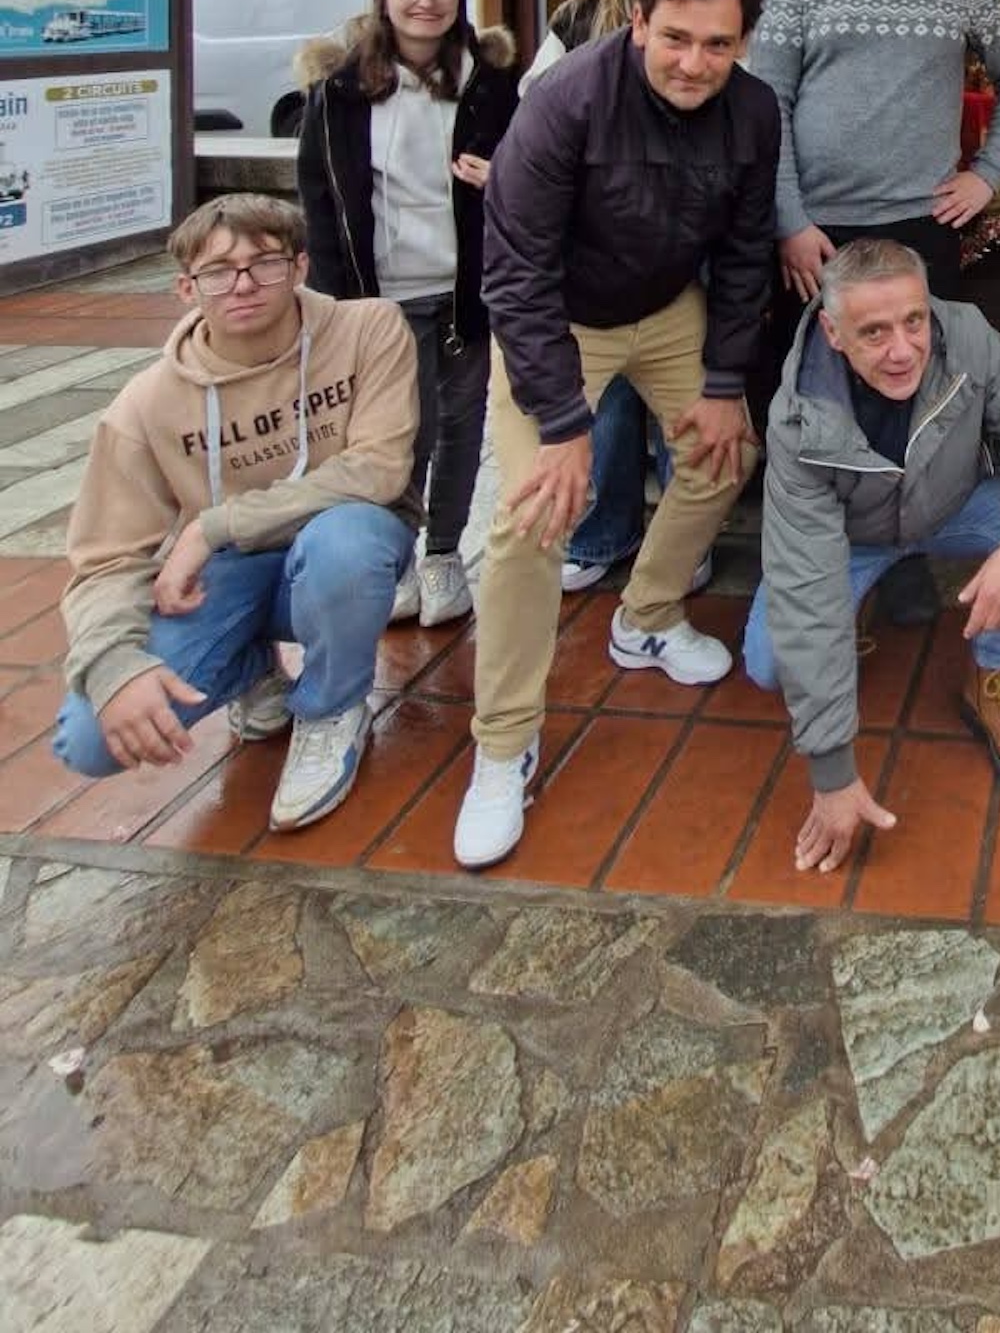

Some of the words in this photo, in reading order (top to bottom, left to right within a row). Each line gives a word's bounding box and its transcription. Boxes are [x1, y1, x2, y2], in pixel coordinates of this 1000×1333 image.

[253, 409, 282, 436] OF
[230, 437, 301, 470] CLASSIC
[641, 635, 667, 656] N
